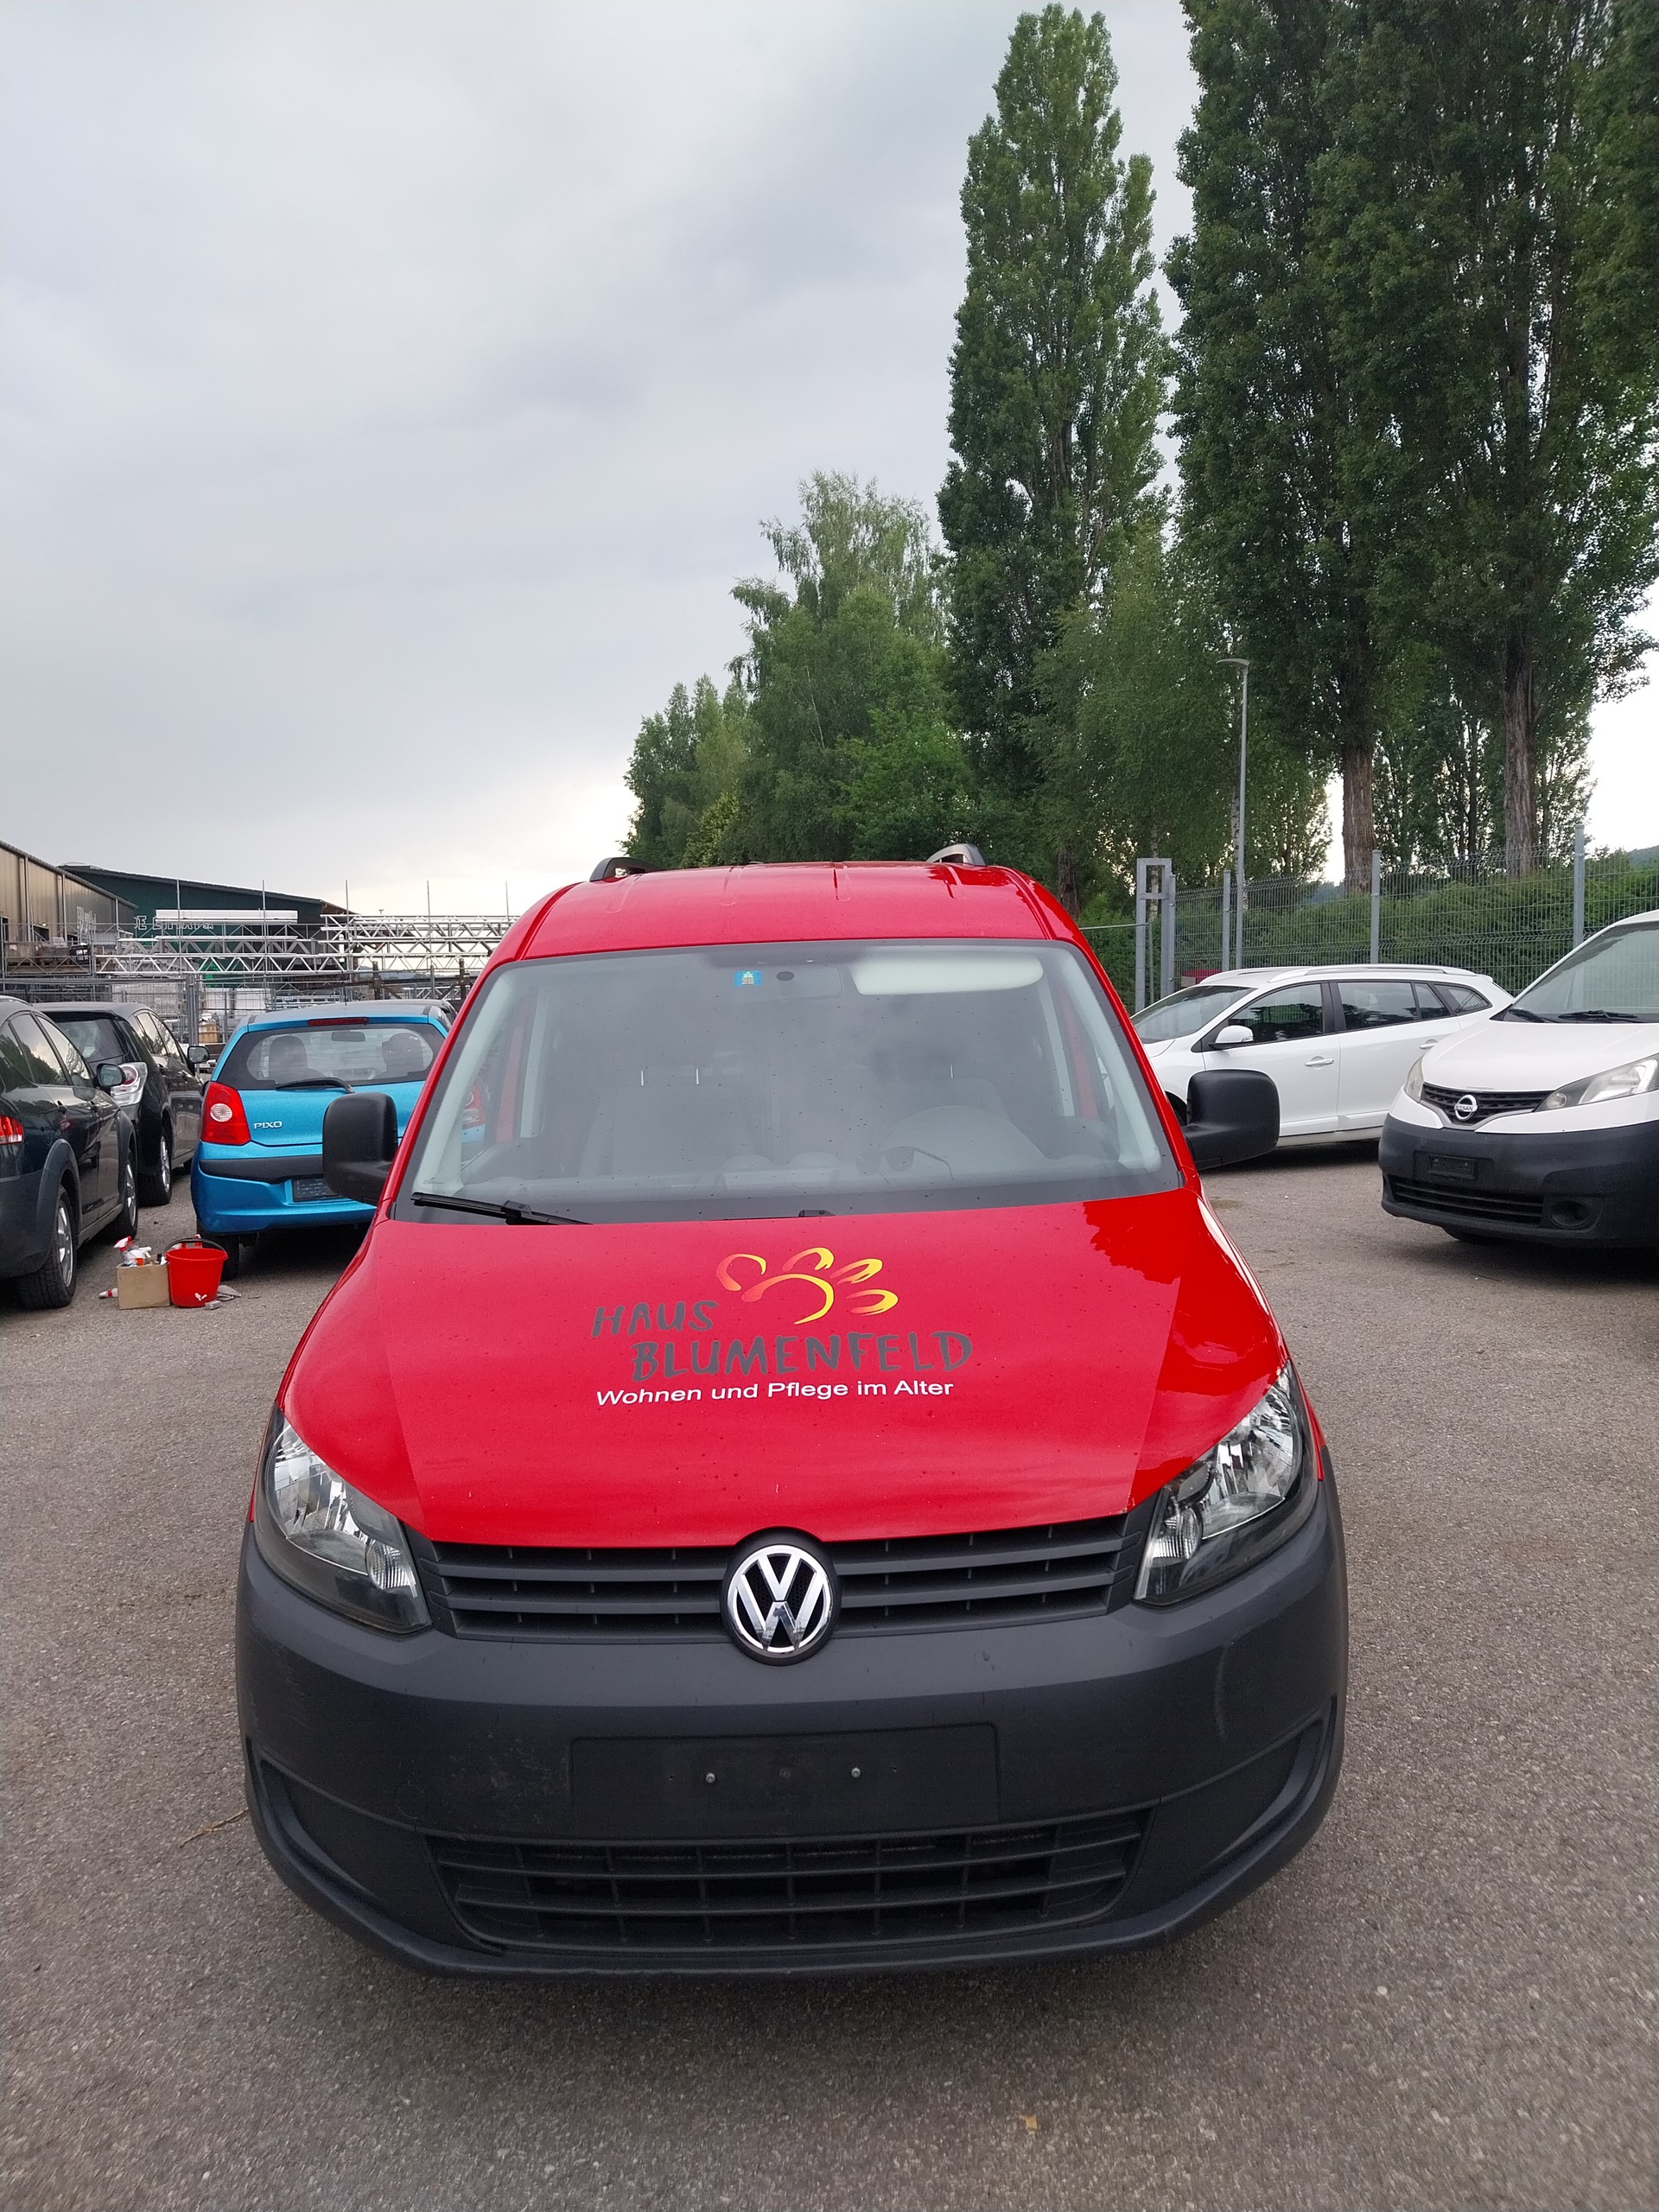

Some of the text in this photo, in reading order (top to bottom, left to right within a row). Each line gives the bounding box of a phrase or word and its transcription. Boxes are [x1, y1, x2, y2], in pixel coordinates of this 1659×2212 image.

[253, 1121, 283, 1129] PIXO
[591, 1300, 719, 1338] HAUS
[631, 1331, 973, 1382] BLUMENFELD
[596, 1380, 954, 1406] Wohnen und Pflege im Alter
